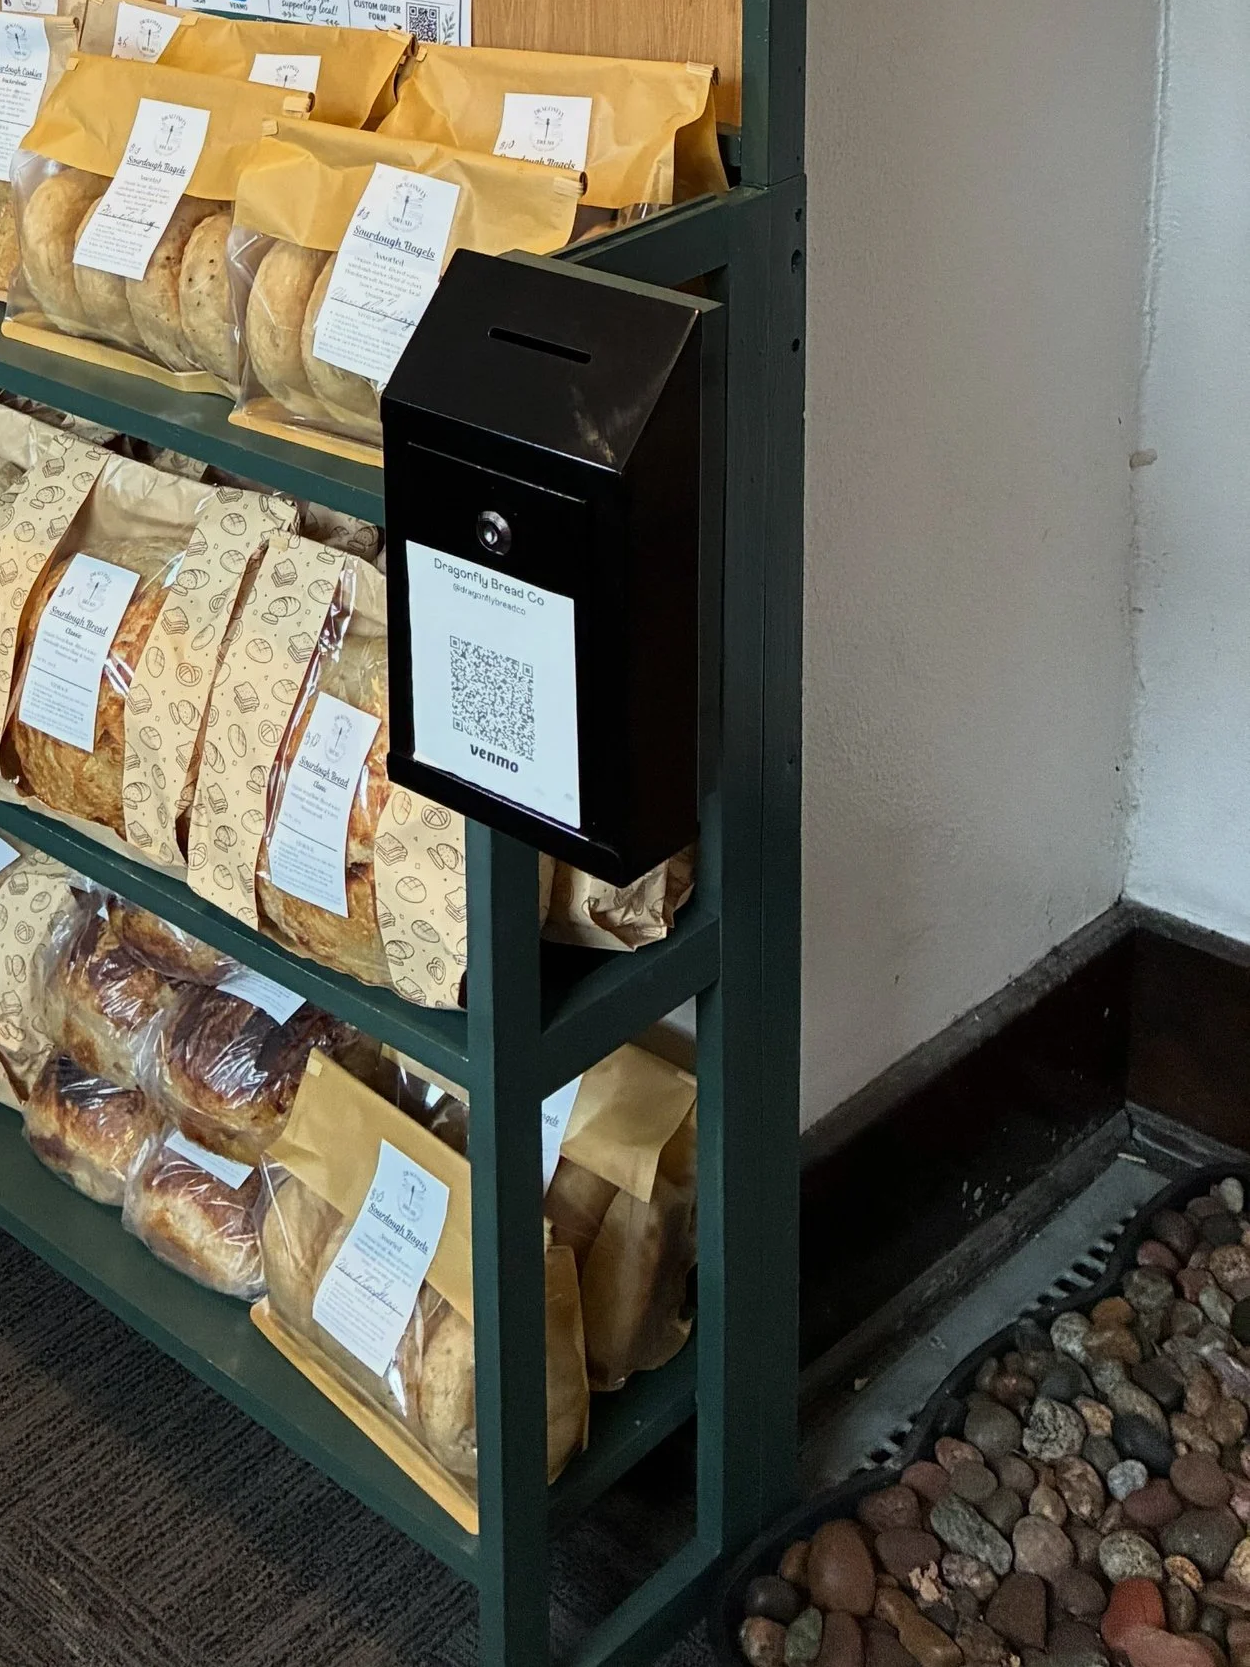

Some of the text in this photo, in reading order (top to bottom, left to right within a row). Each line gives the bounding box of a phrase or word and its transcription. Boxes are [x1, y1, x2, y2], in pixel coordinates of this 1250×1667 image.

[282, 0, 338, 16] supporting local!
[353, 0, 401, 14] CUSTOM ORDER
[368, 12, 386, 22] FORM
[126, 156, 163, 172] Sourdough
[354, 225, 436, 259] Sourdough Bagels
[374, 252, 405, 267] Assorted
[433, 558, 545, 607] Dragonfly Bread Co
[453, 582, 526, 616] @dragonflybreadco
[50, 605, 108, 636] Sourdough Bread
[299, 755, 349, 788] Sourdough Bread
[470, 744, 519, 774] venmo
[368, 1202, 429, 1253] Sourdough Bagels
